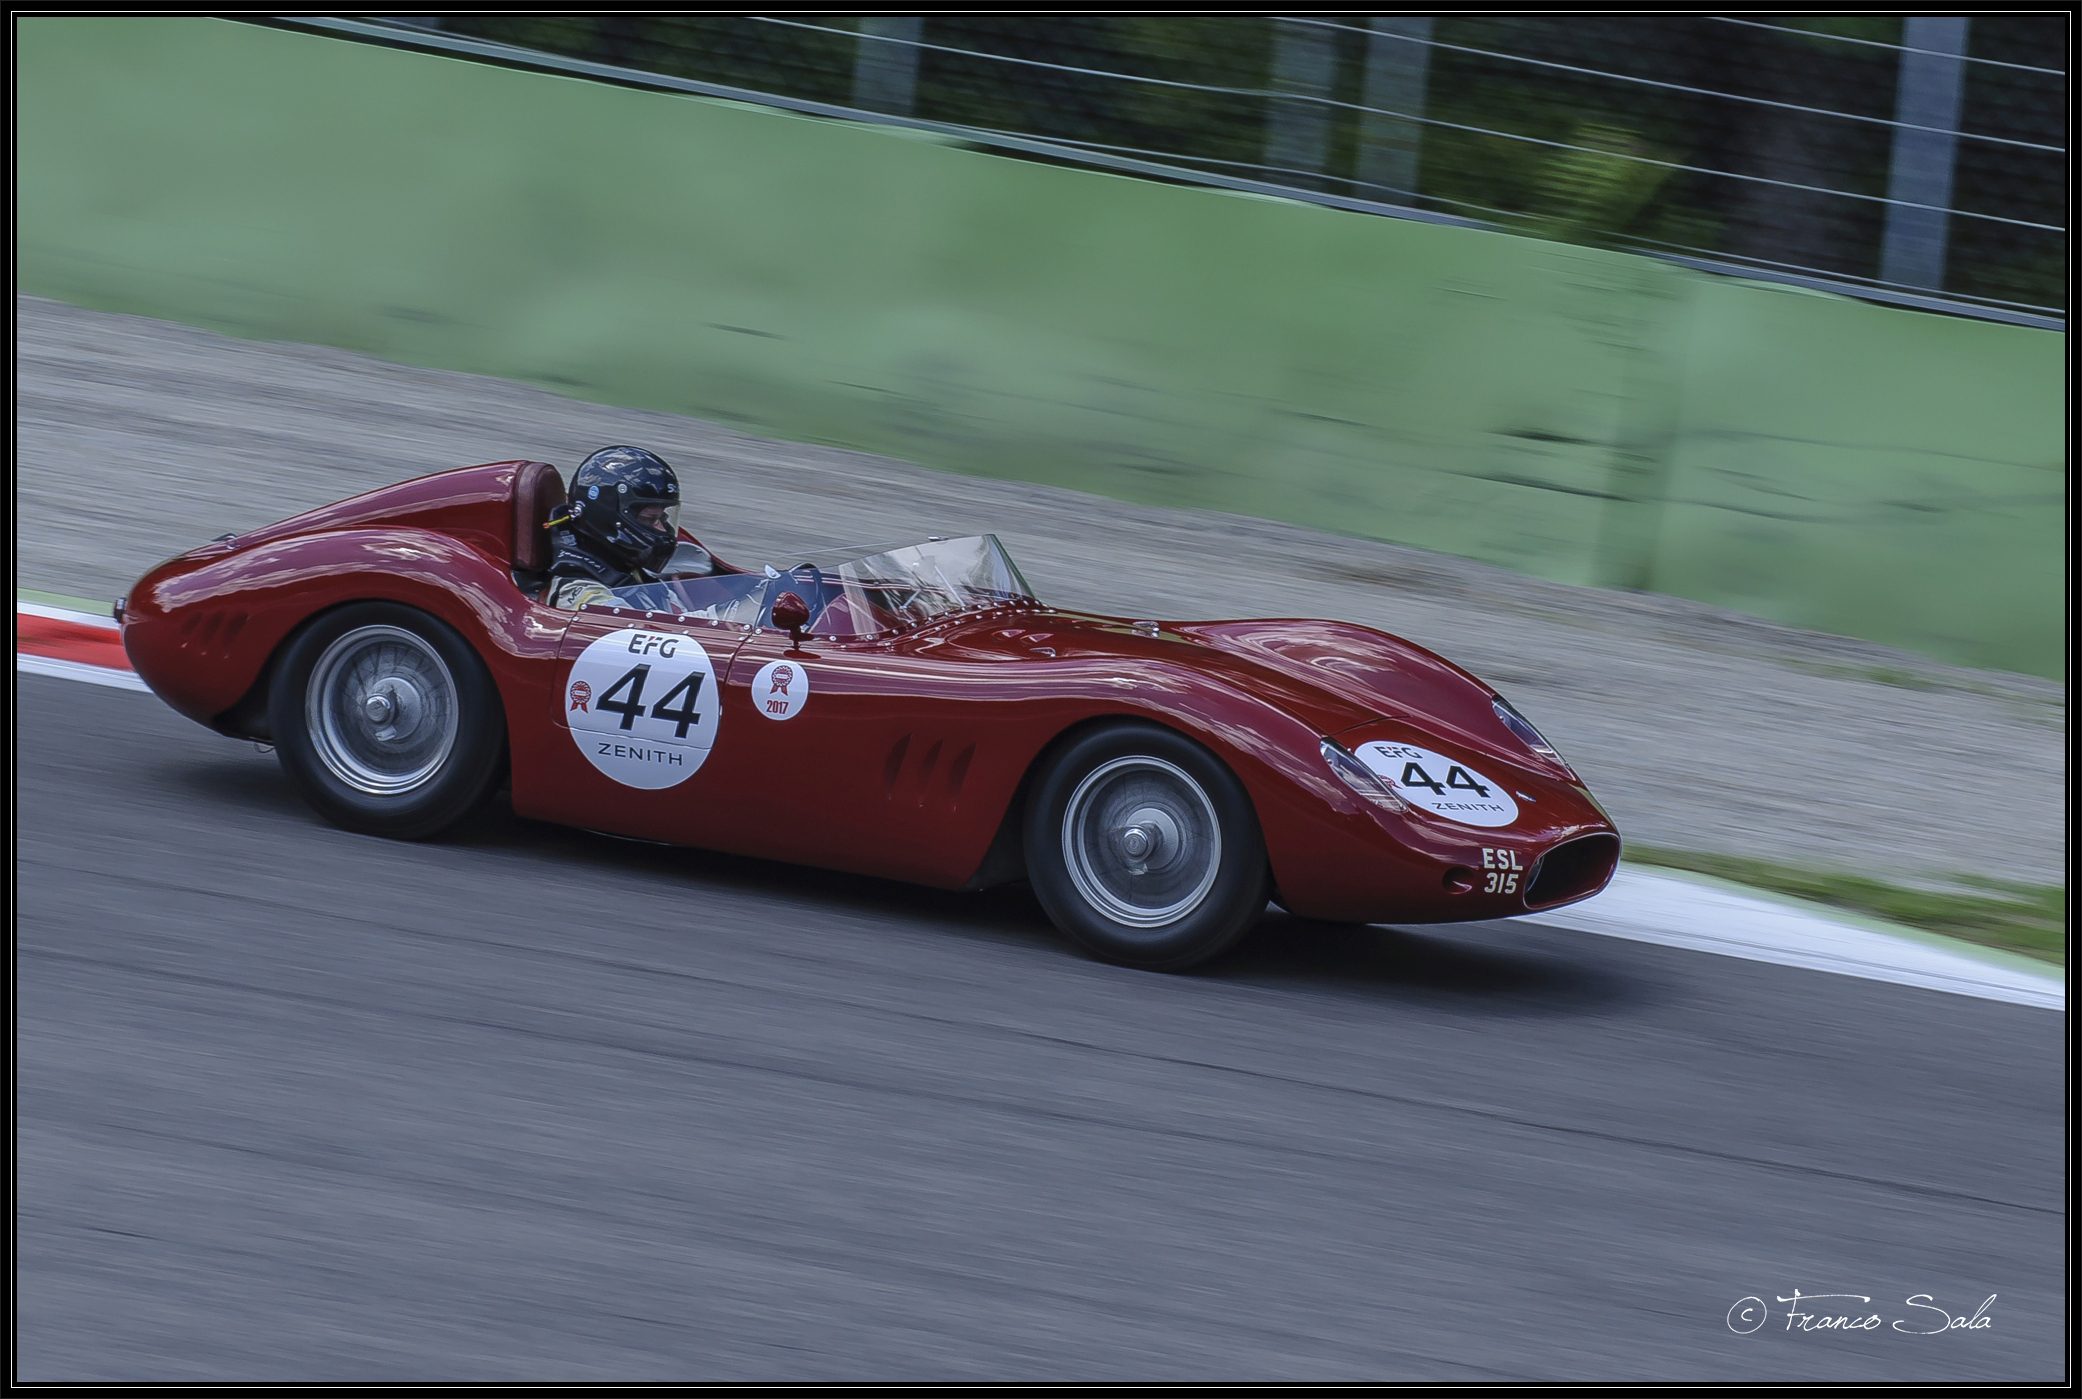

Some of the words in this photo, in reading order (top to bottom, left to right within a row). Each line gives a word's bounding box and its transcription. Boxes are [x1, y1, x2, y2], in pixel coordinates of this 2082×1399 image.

[628, 633, 679, 659] EFG
[595, 663, 706, 739] 44
[766, 700, 789, 715] 2017
[597, 742, 683, 766] ZENITH
[1373, 746, 1423, 760] EFG
[1400, 761, 1491, 798] 44
[1431, 802, 1504, 812] ZENITH
[1482, 848, 1523, 871] ESL
[1484, 872, 1518, 894] 315
